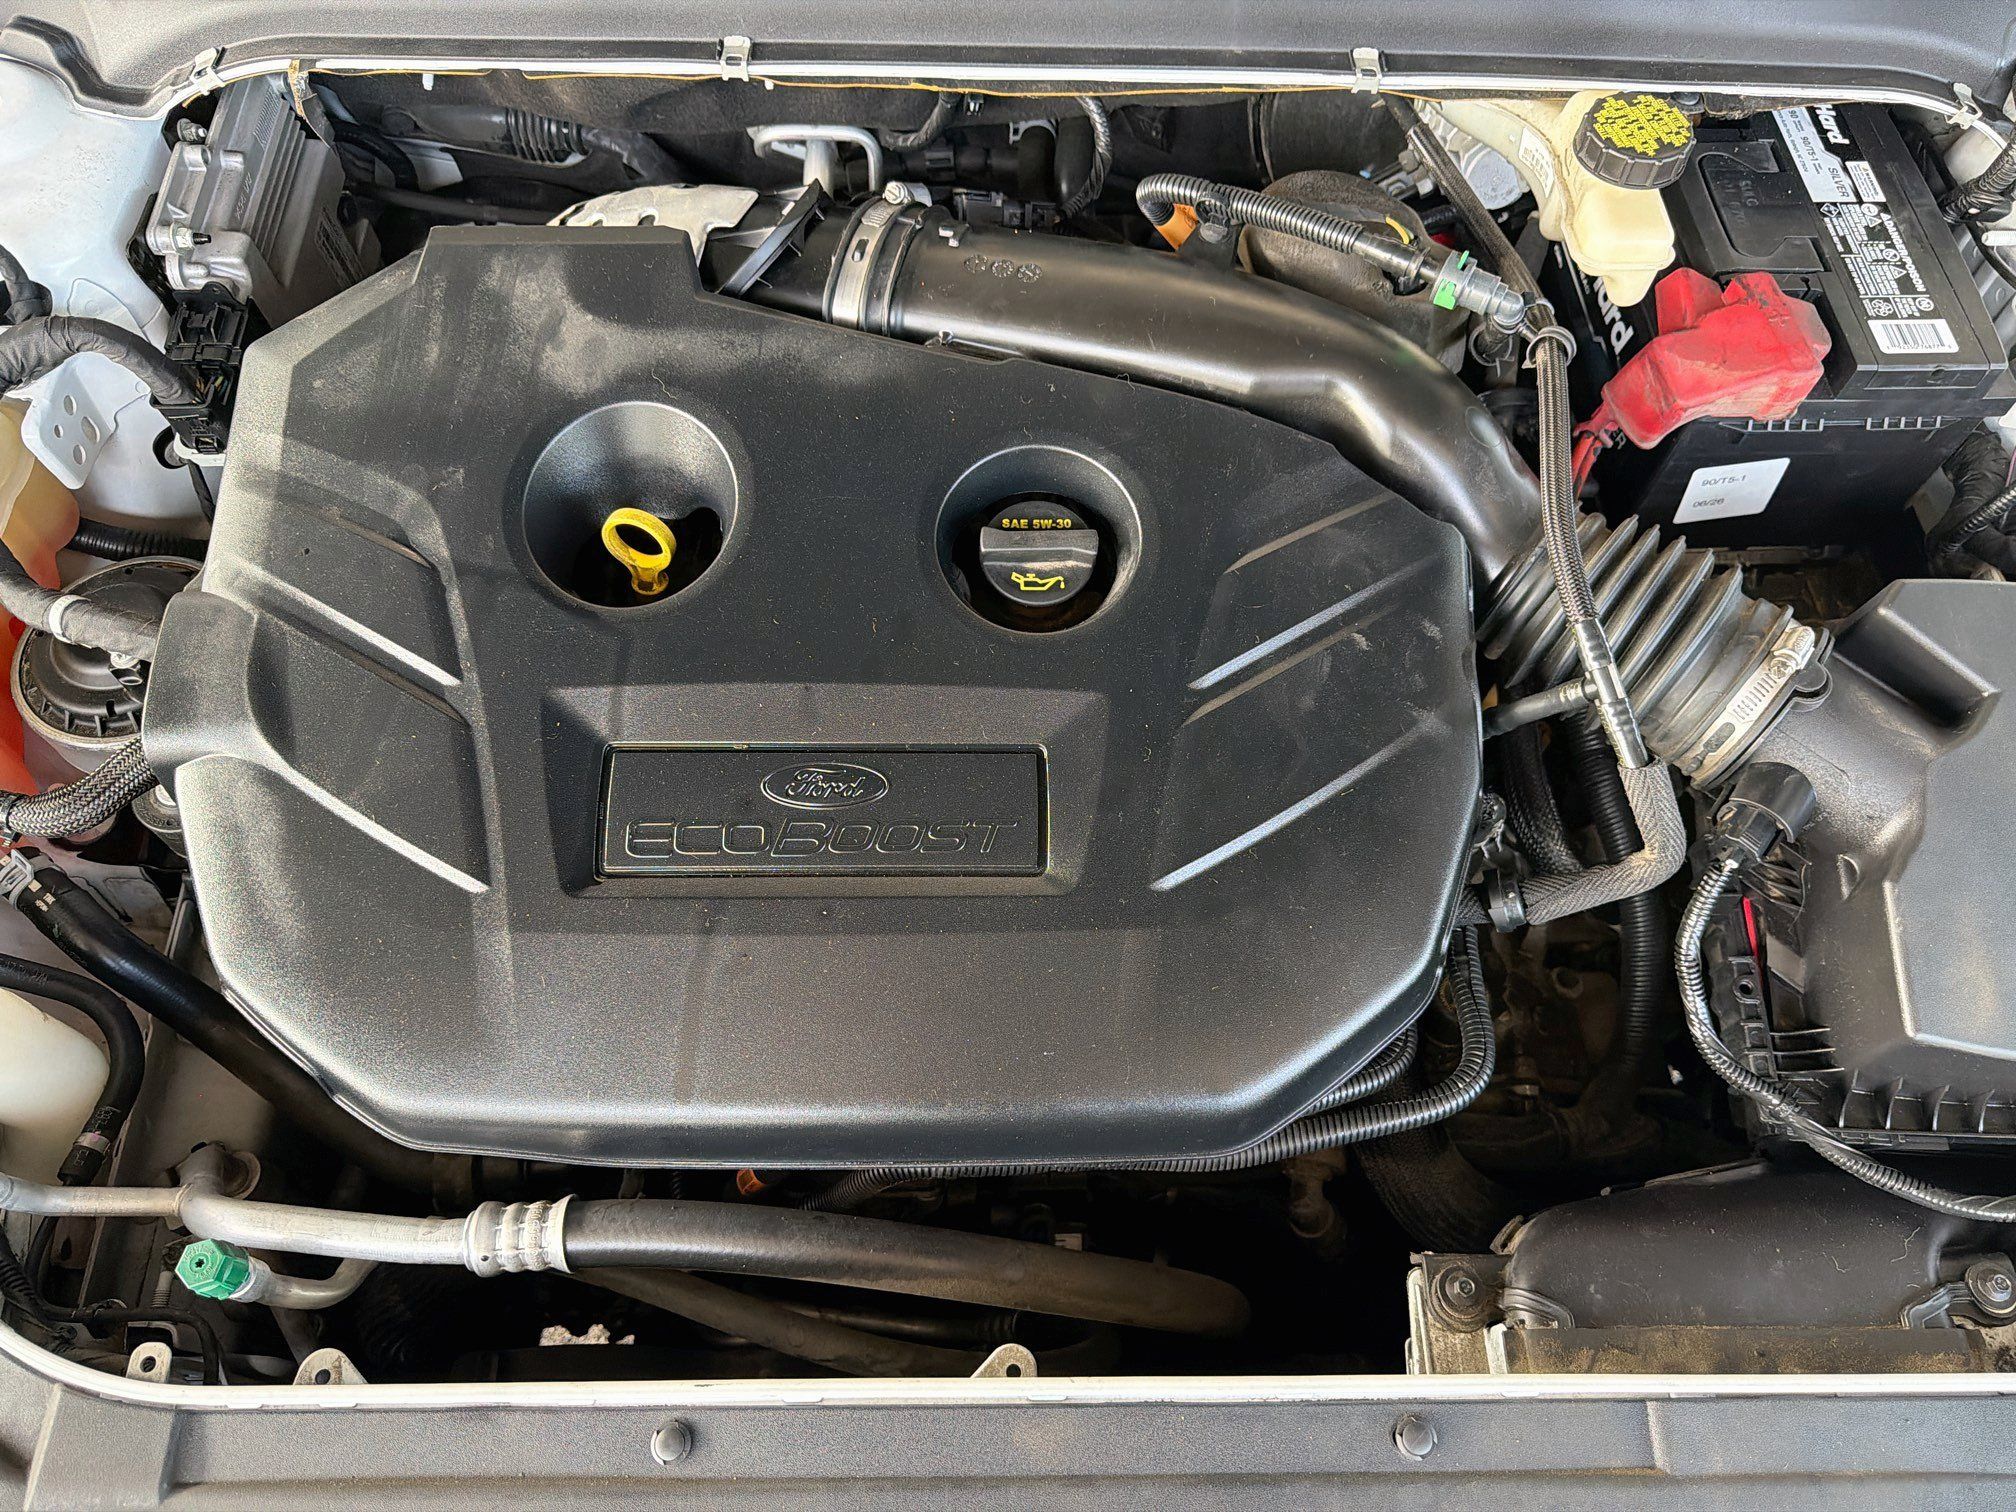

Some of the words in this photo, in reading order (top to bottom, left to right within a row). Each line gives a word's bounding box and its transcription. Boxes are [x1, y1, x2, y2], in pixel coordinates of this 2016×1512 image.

[1827, 167, 1850, 198] SILVER
[1884, 220, 1927, 292] DANGER/POISON
[1701, 475, 1747, 487] 90/T5-1
[1002, 518, 1029, 529] SAE
[1032, 518, 1072, 529] 5W-30
[784, 765, 866, 799] Ford
